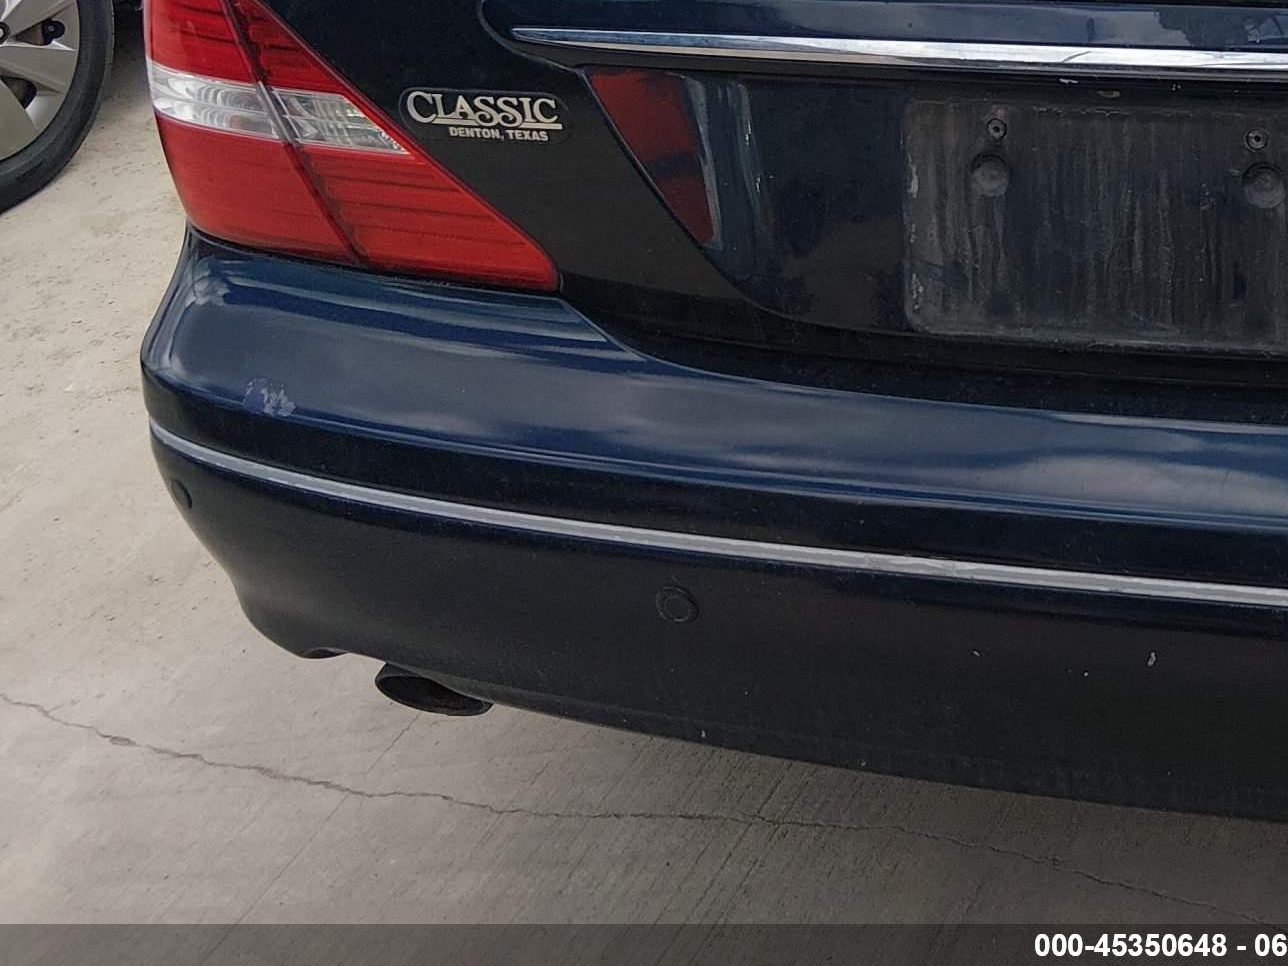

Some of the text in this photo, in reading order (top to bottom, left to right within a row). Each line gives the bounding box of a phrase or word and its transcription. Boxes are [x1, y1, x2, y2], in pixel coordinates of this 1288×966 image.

[406, 90, 560, 128] CLASSIC
[449, 126, 549, 142] DENTON, TEXAS
